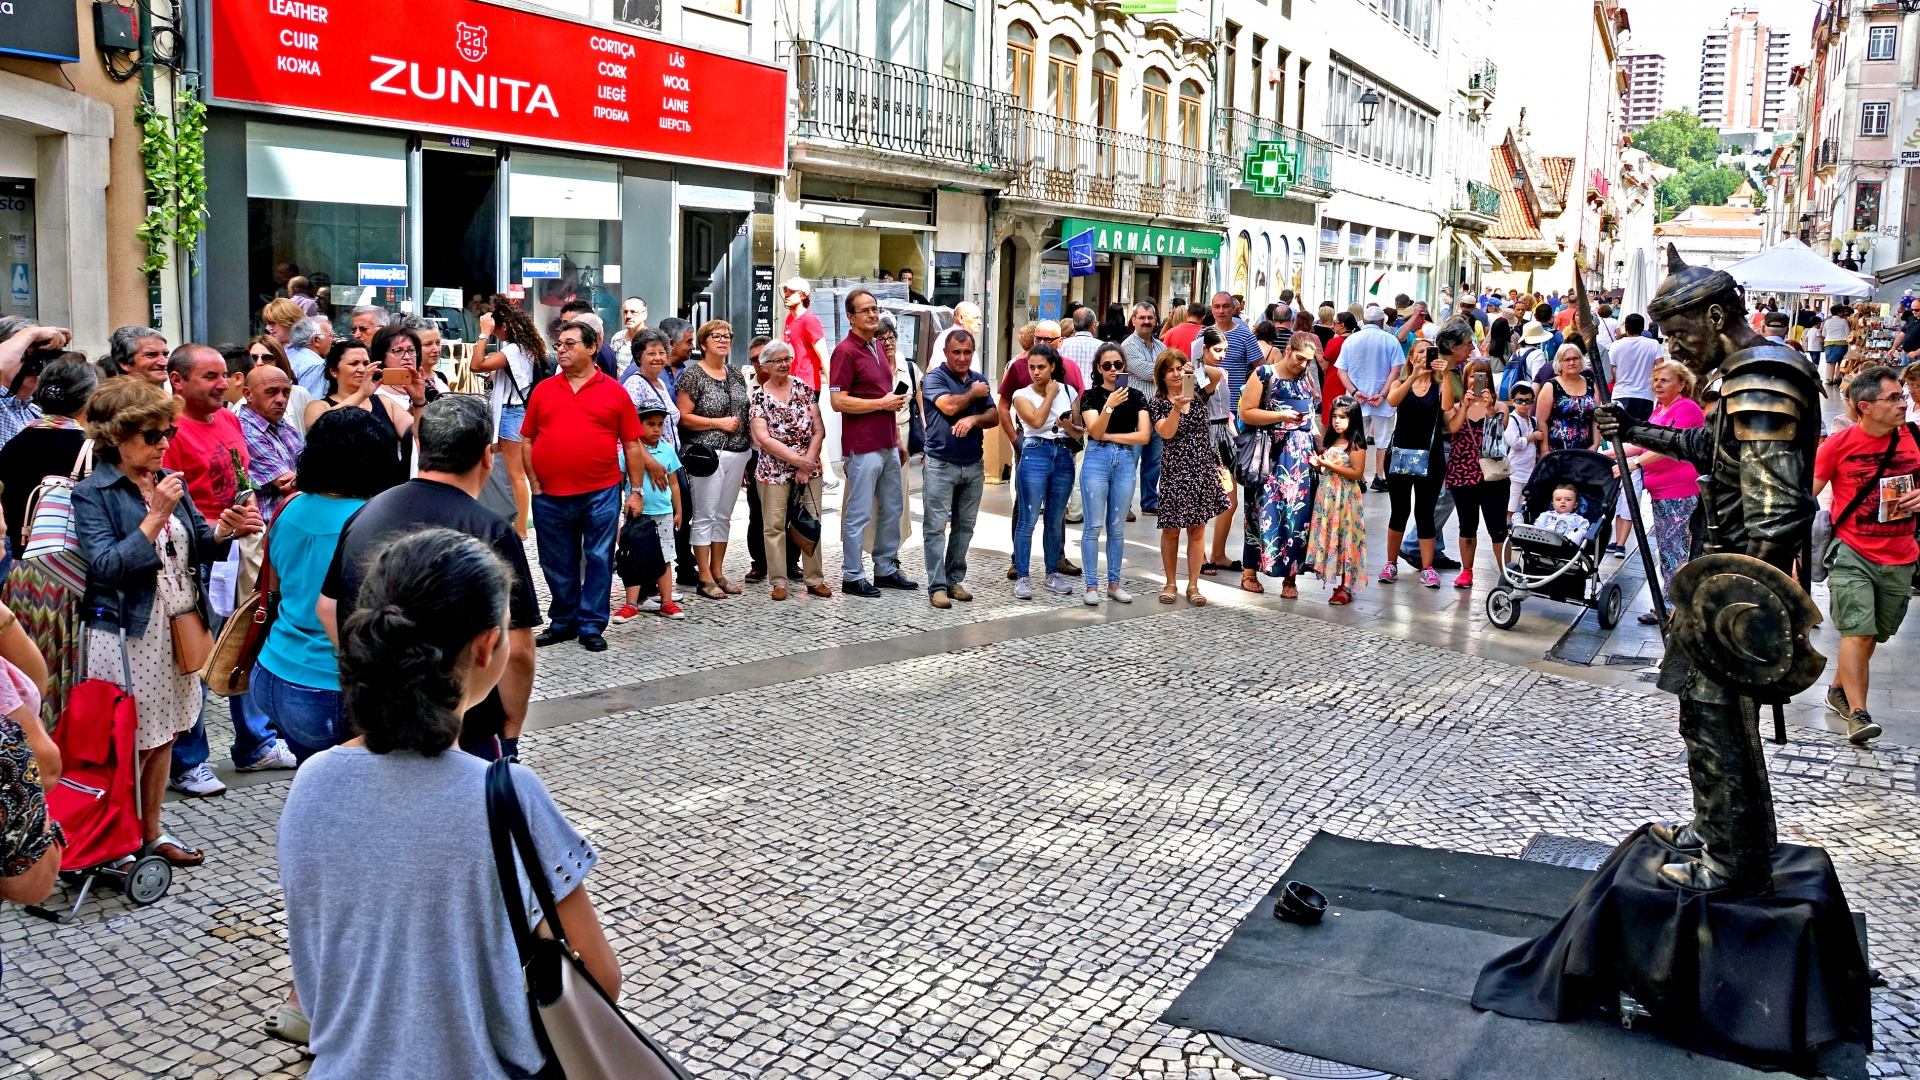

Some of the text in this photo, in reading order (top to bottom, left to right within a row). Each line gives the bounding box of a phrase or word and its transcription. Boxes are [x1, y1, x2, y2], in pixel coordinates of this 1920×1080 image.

[269, 0, 328, 24] LEATHER
[280, 29, 319, 51] CUIR
[590, 35, 636, 60] CORTIÇA
[277, 55, 321, 77] КОЖА
[669, 52, 685, 69] LÃS
[598, 61, 628, 80] CORK
[370, 55, 560, 119] ZUNITA
[662, 74, 691, 92] WOOL
[598, 85, 627, 103] LIEGÈ
[662, 96, 690, 113] LAINE
[593, 105, 630, 123] ПРОБКА
[659, 116, 692, 133] ШЕРСТЬ
[451, 135, 471, 149] 44/46
[1901, 151, 1920, 159] CRIS
[737, 226, 747, 235] 42
[1086, 227, 1185, 255] ARMÁCIA
[360, 267, 406, 283] PROMOÇÕES
[522, 260, 560, 275] PROMOÇÕES
[755, 282, 772, 291] Maria
